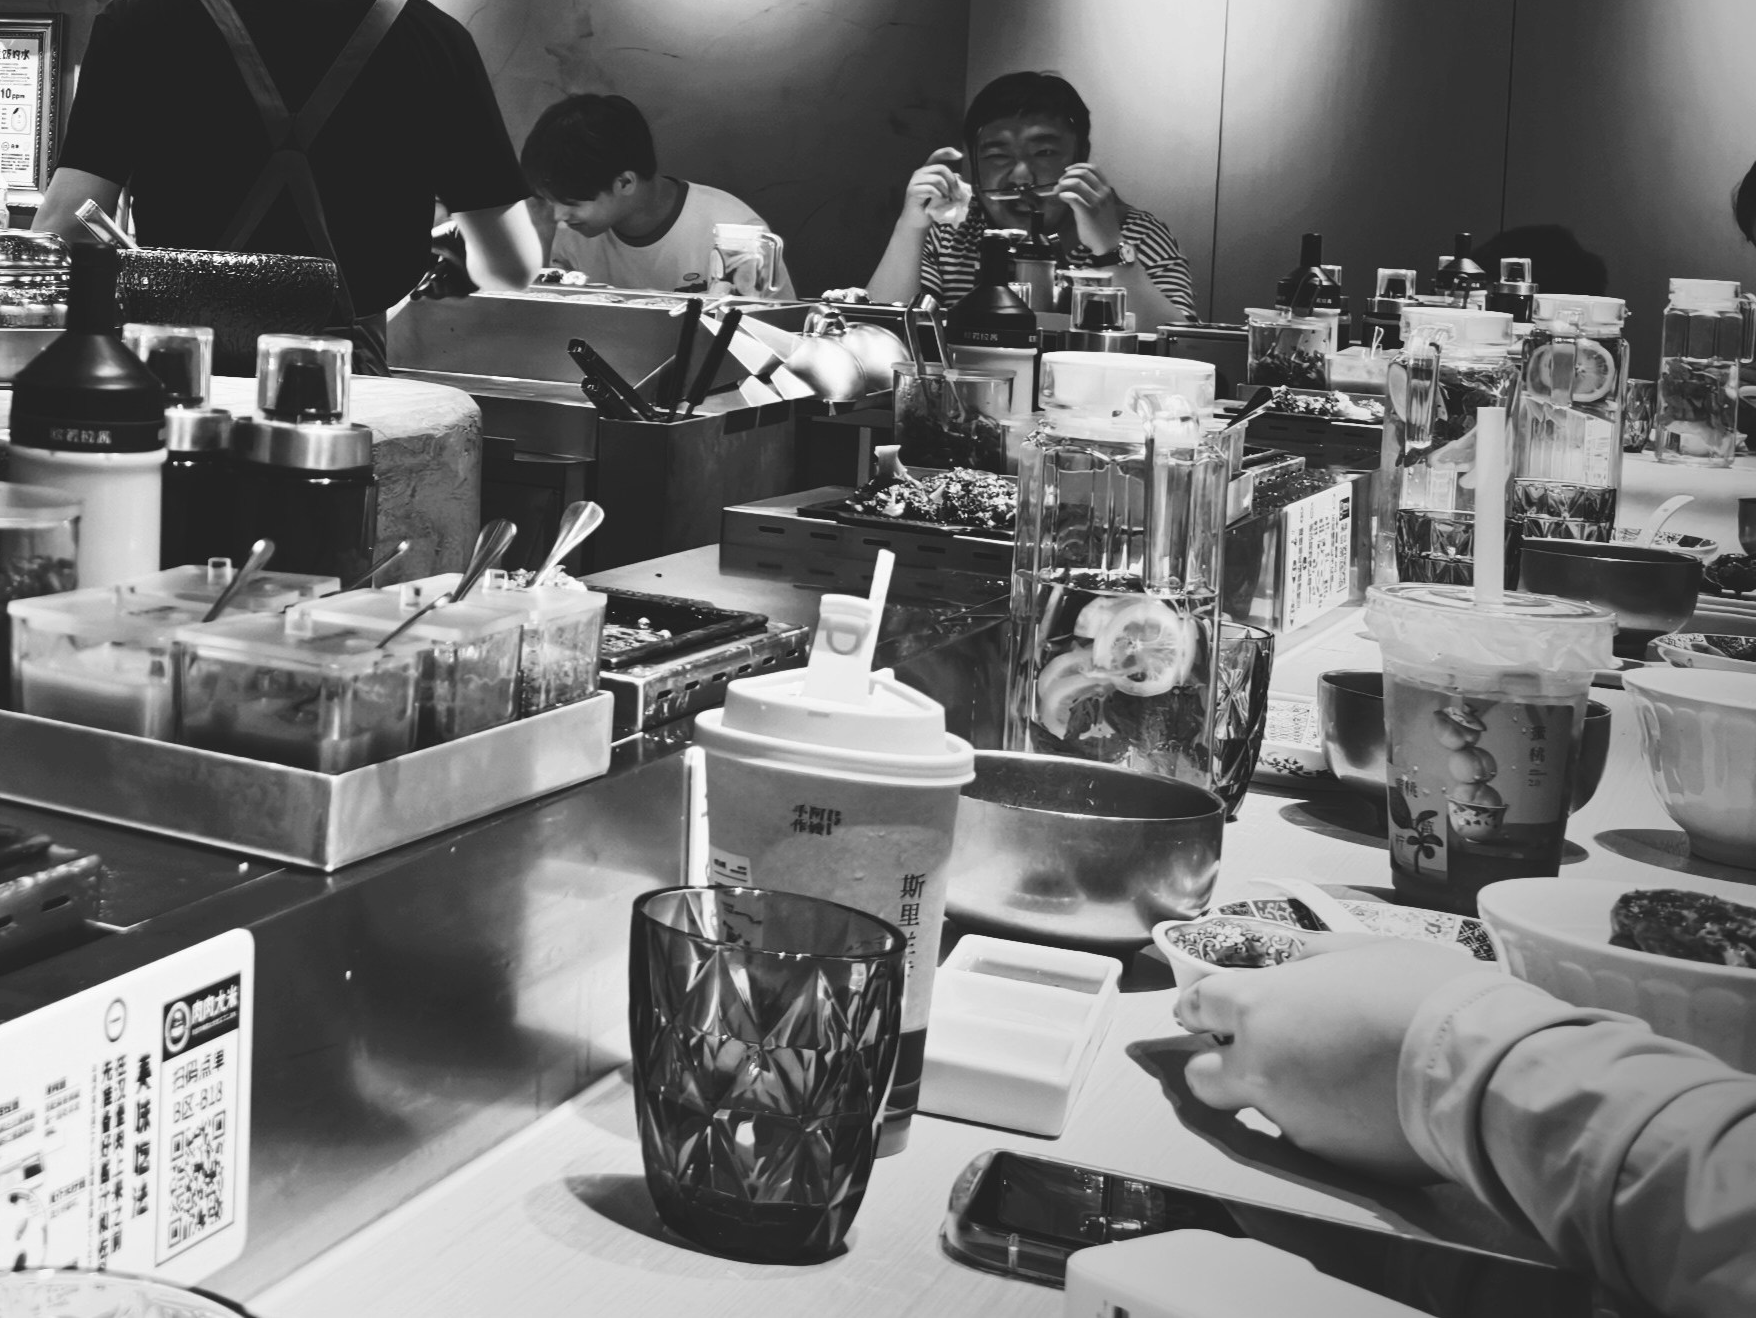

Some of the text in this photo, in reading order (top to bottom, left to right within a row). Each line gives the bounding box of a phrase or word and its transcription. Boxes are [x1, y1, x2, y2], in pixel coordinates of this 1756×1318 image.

[191, 984, 238, 1024] 肉肉大米
[172, 1049, 225, 1094] 扫码点单
